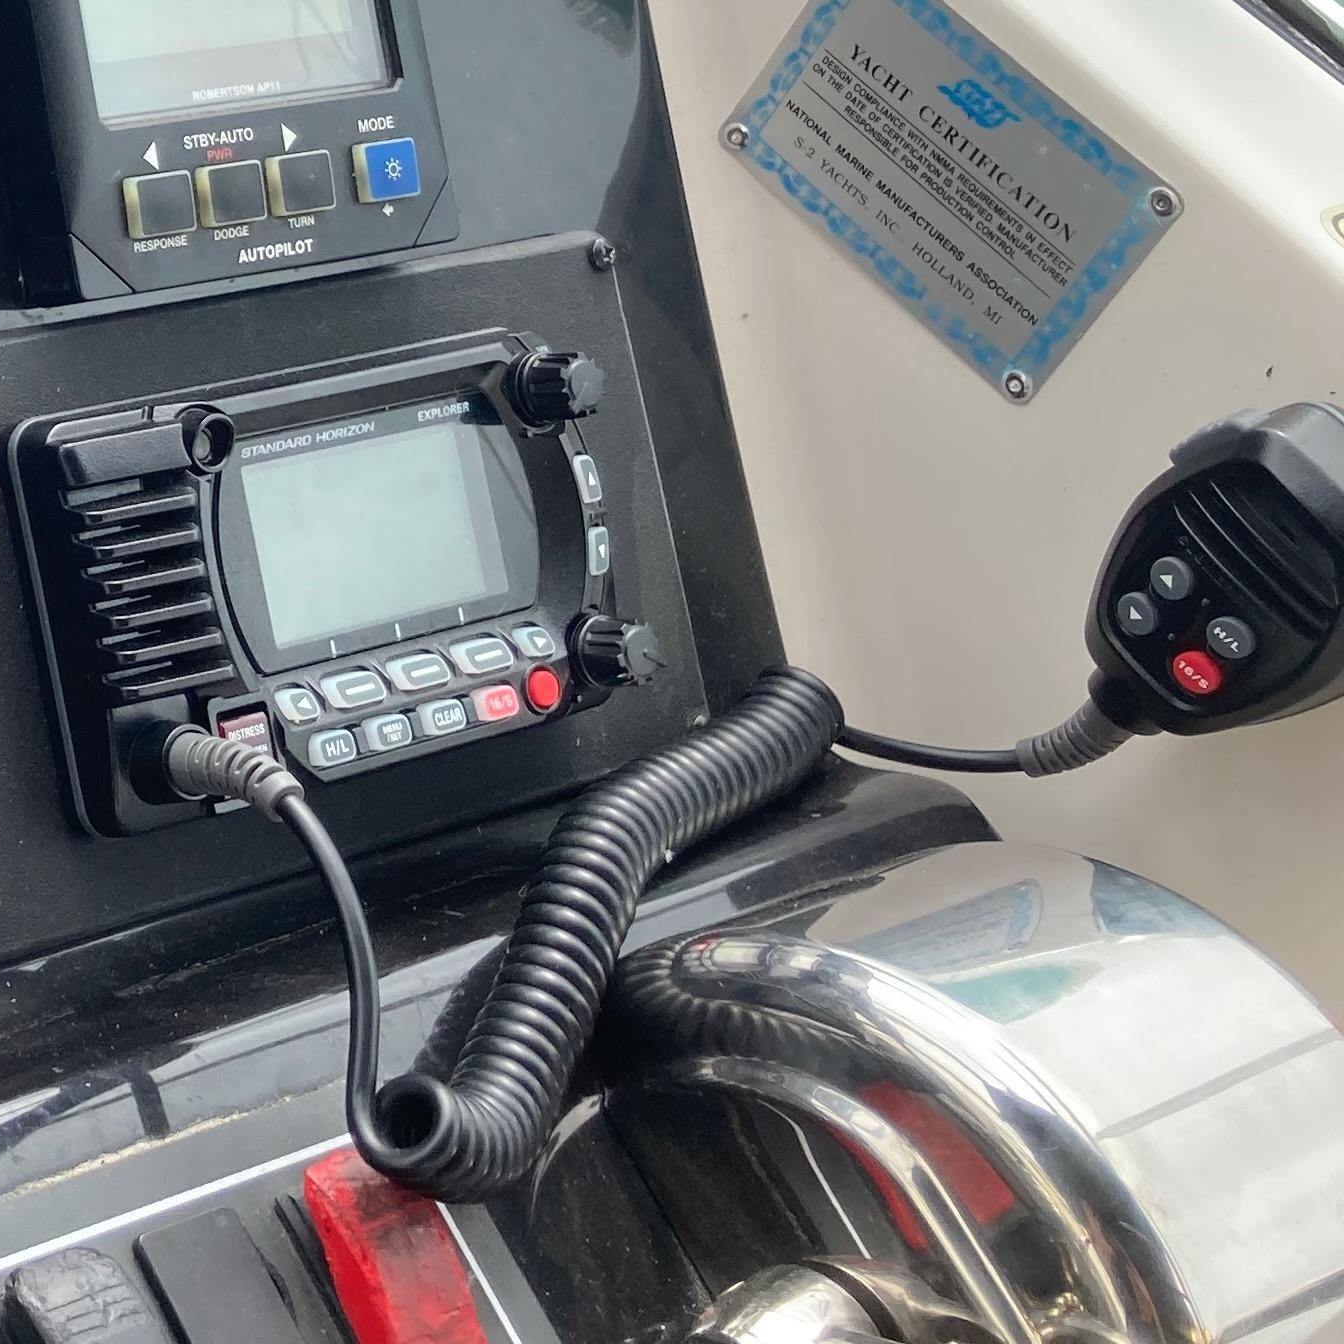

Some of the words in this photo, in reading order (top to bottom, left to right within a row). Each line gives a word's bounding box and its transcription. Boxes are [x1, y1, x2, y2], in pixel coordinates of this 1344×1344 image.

[192, 84, 255, 102] ROBERTSON
[358, 115, 395, 133] MODE
[183, 127, 254, 150] STBY-AUTO
[849, 43, 913, 102] YACHT
[918, 105, 1077, 243] CERTIFICATION
[206, 148, 233, 161] PWR
[822, 56, 853, 85] DESIGN
[853, 83, 906, 130] COMPLIANCE
[907, 128, 929, 151] WITH
[930, 149, 955, 176] NMMA
[957, 174, 1024, 233] REQUIREMENTS
[1025, 231, 1036, 243] IN
[1037, 242, 1073, 273] EFFECT
[843, 105, 900, 156] RESPONSIBLE
[900, 154, 919, 174] FOR
[920, 172, 975, 222] PRODUCTION
[812, 63, 826, 77] ON
[827, 74, 845, 93] THE
[845, 91, 866, 113] DATE
[868, 111, 881, 123] OF
[882, 123, 943, 179] CERTIFICATION
[943, 175, 953, 188] IS
[997, 222, 1068, 288] MANUFACTURER
[288, 216, 315, 229] TURN
[784, 99, 832, 146] NATIONAL
[835, 143, 875, 182] MARINE
[875, 179, 965, 262] MANUFACTURERS
[966, 262, 1039, 326] ASSOCIATION
[214, 226, 249, 241] DODGE
[133, 235, 188, 253] RESPONSE
[238, 239, 314, 264] AUTOPILOT
[983, 305, 1002, 325] MI
[417, 402, 469, 422] EXPLORER
[241, 434, 312, 459] STANDARD
[316, 422, 375, 443] HORIZON
[1213, 626, 1239, 653] H/L
[1179, 661, 1209, 689] 16/S
[488, 694, 513, 711] 16/S
[434, 708, 462, 726] CLEAR
[228, 723, 266, 741] DISTRESS
[326, 740, 350, 756] H/L
